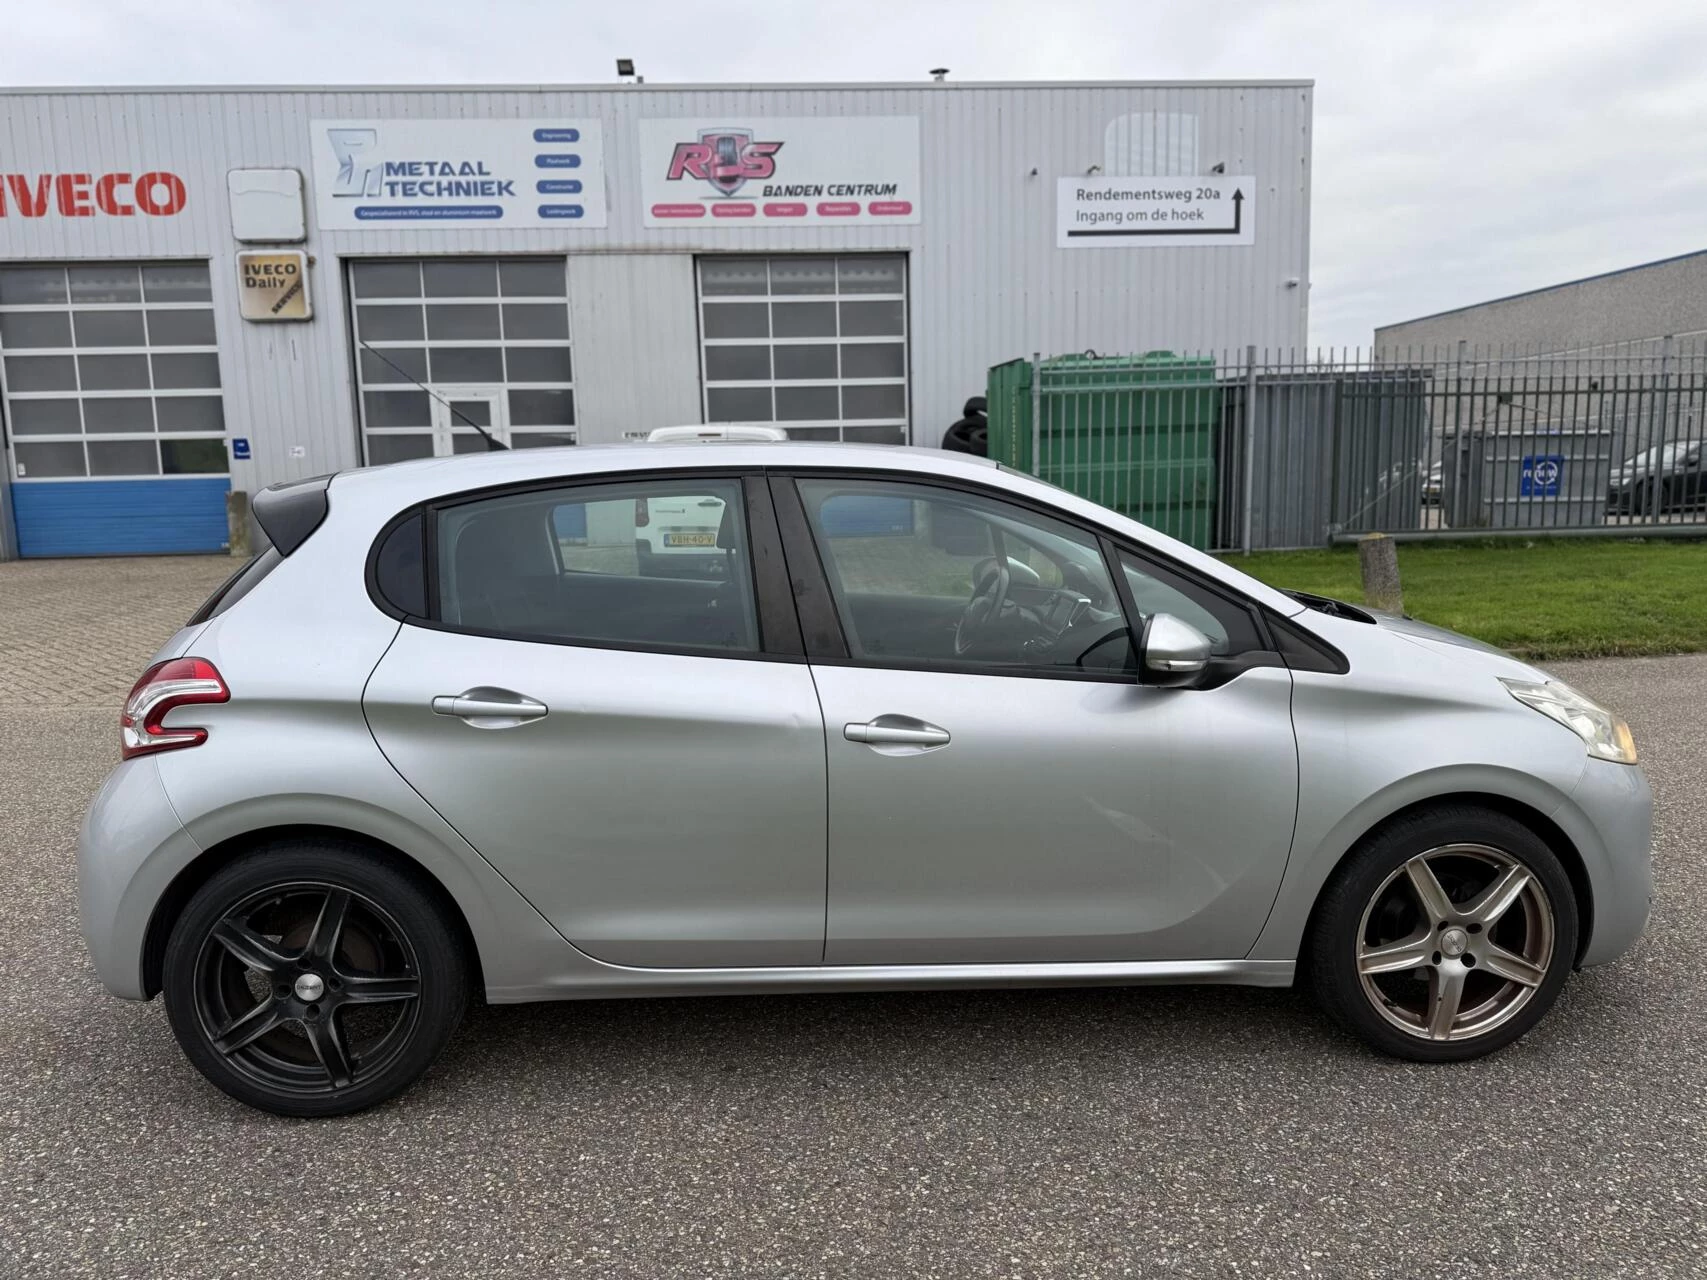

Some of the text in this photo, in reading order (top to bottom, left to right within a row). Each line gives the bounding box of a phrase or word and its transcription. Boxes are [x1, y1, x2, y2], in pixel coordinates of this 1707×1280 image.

[385, 161, 492, 177] METAAL
[384, 180, 517, 198] TECHNIEK
[762, 183, 898, 197] BANDEN CENTRUM
[1076, 187, 1221, 203] Rendementsweg 20a
[1076, 208, 1205, 224] Ingang om de hoek
[244, 263, 297, 275] IVECO
[245, 276, 286, 288] Daily
